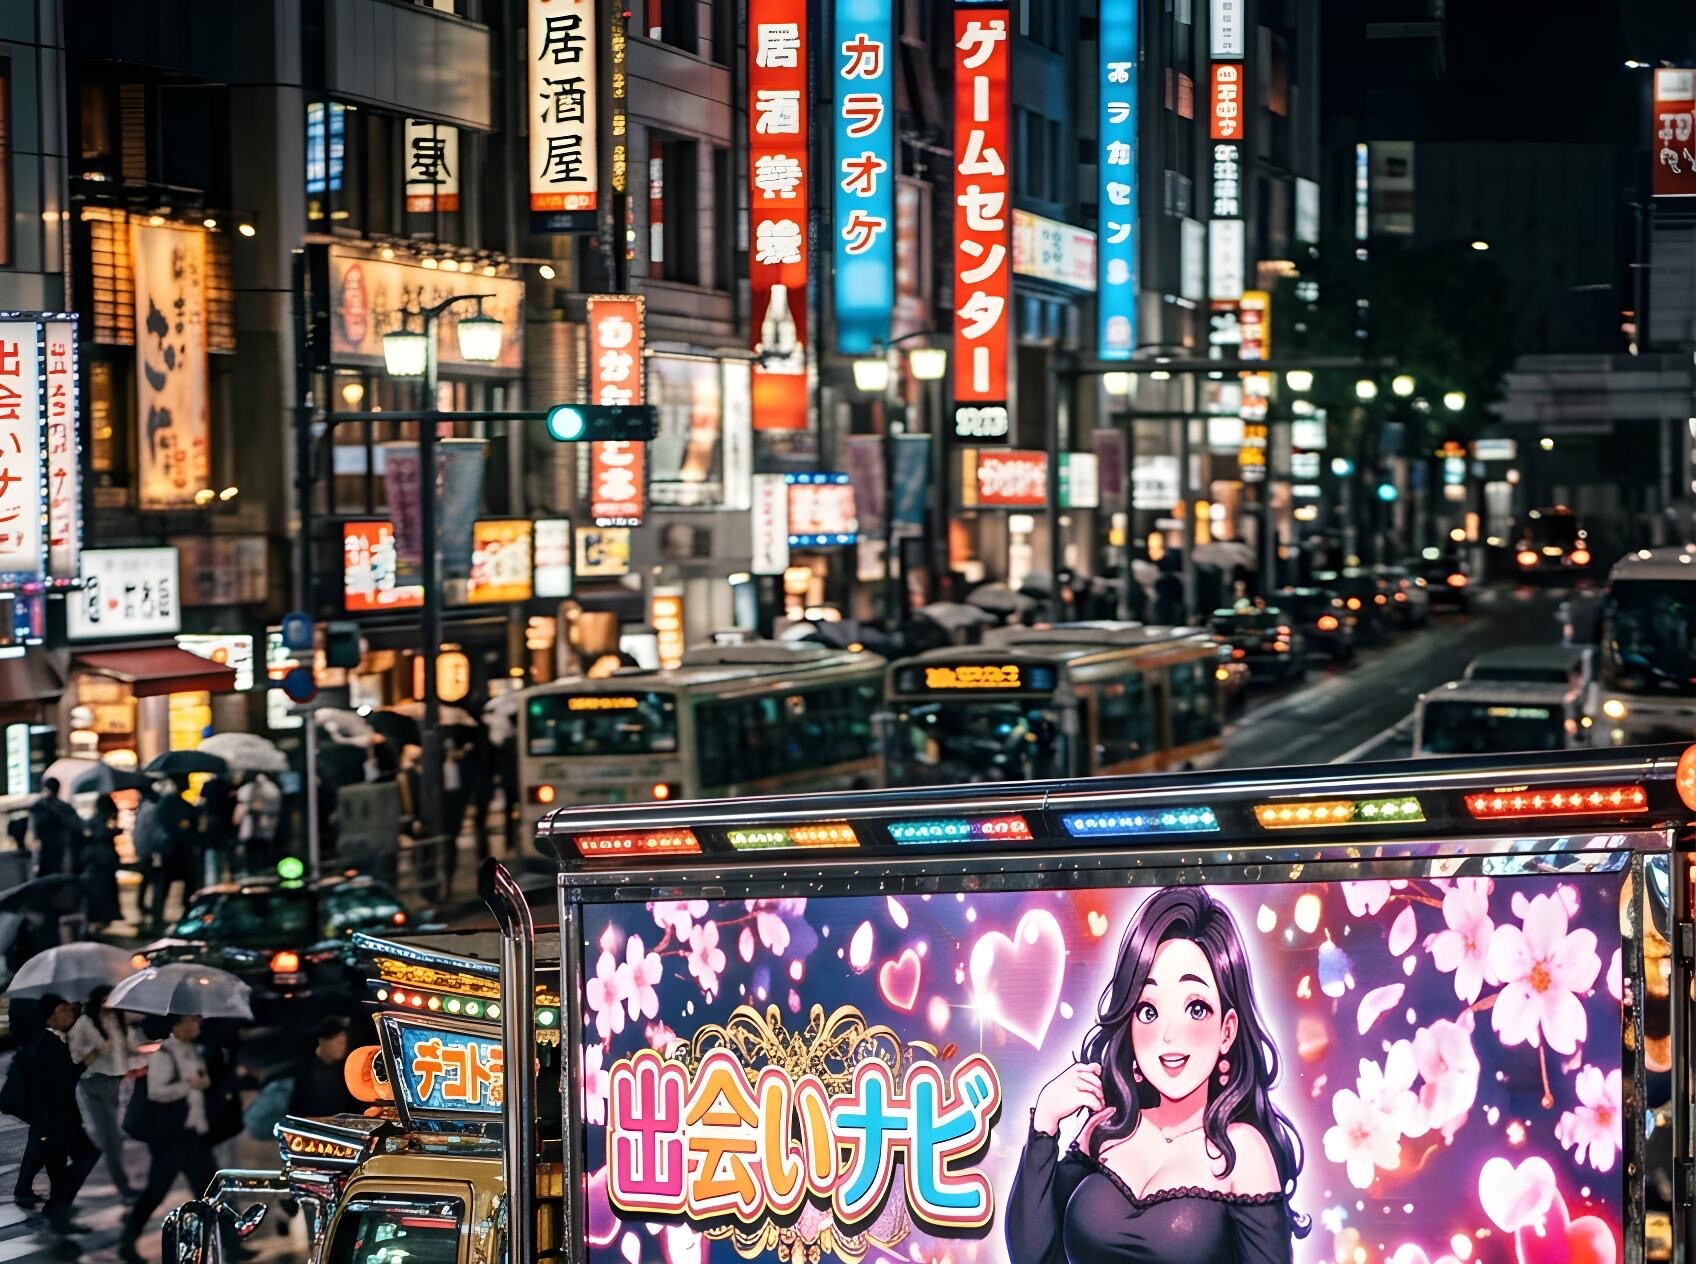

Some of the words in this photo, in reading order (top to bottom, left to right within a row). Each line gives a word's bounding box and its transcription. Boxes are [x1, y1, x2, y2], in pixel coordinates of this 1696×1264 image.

[538, 14, 588, 184] 居酒屋
[840, 33, 887, 255] カラオケ
[955, 20, 1007, 393] ゲームセンター
[609, 1049, 1000, 1230] 出会いナビ
